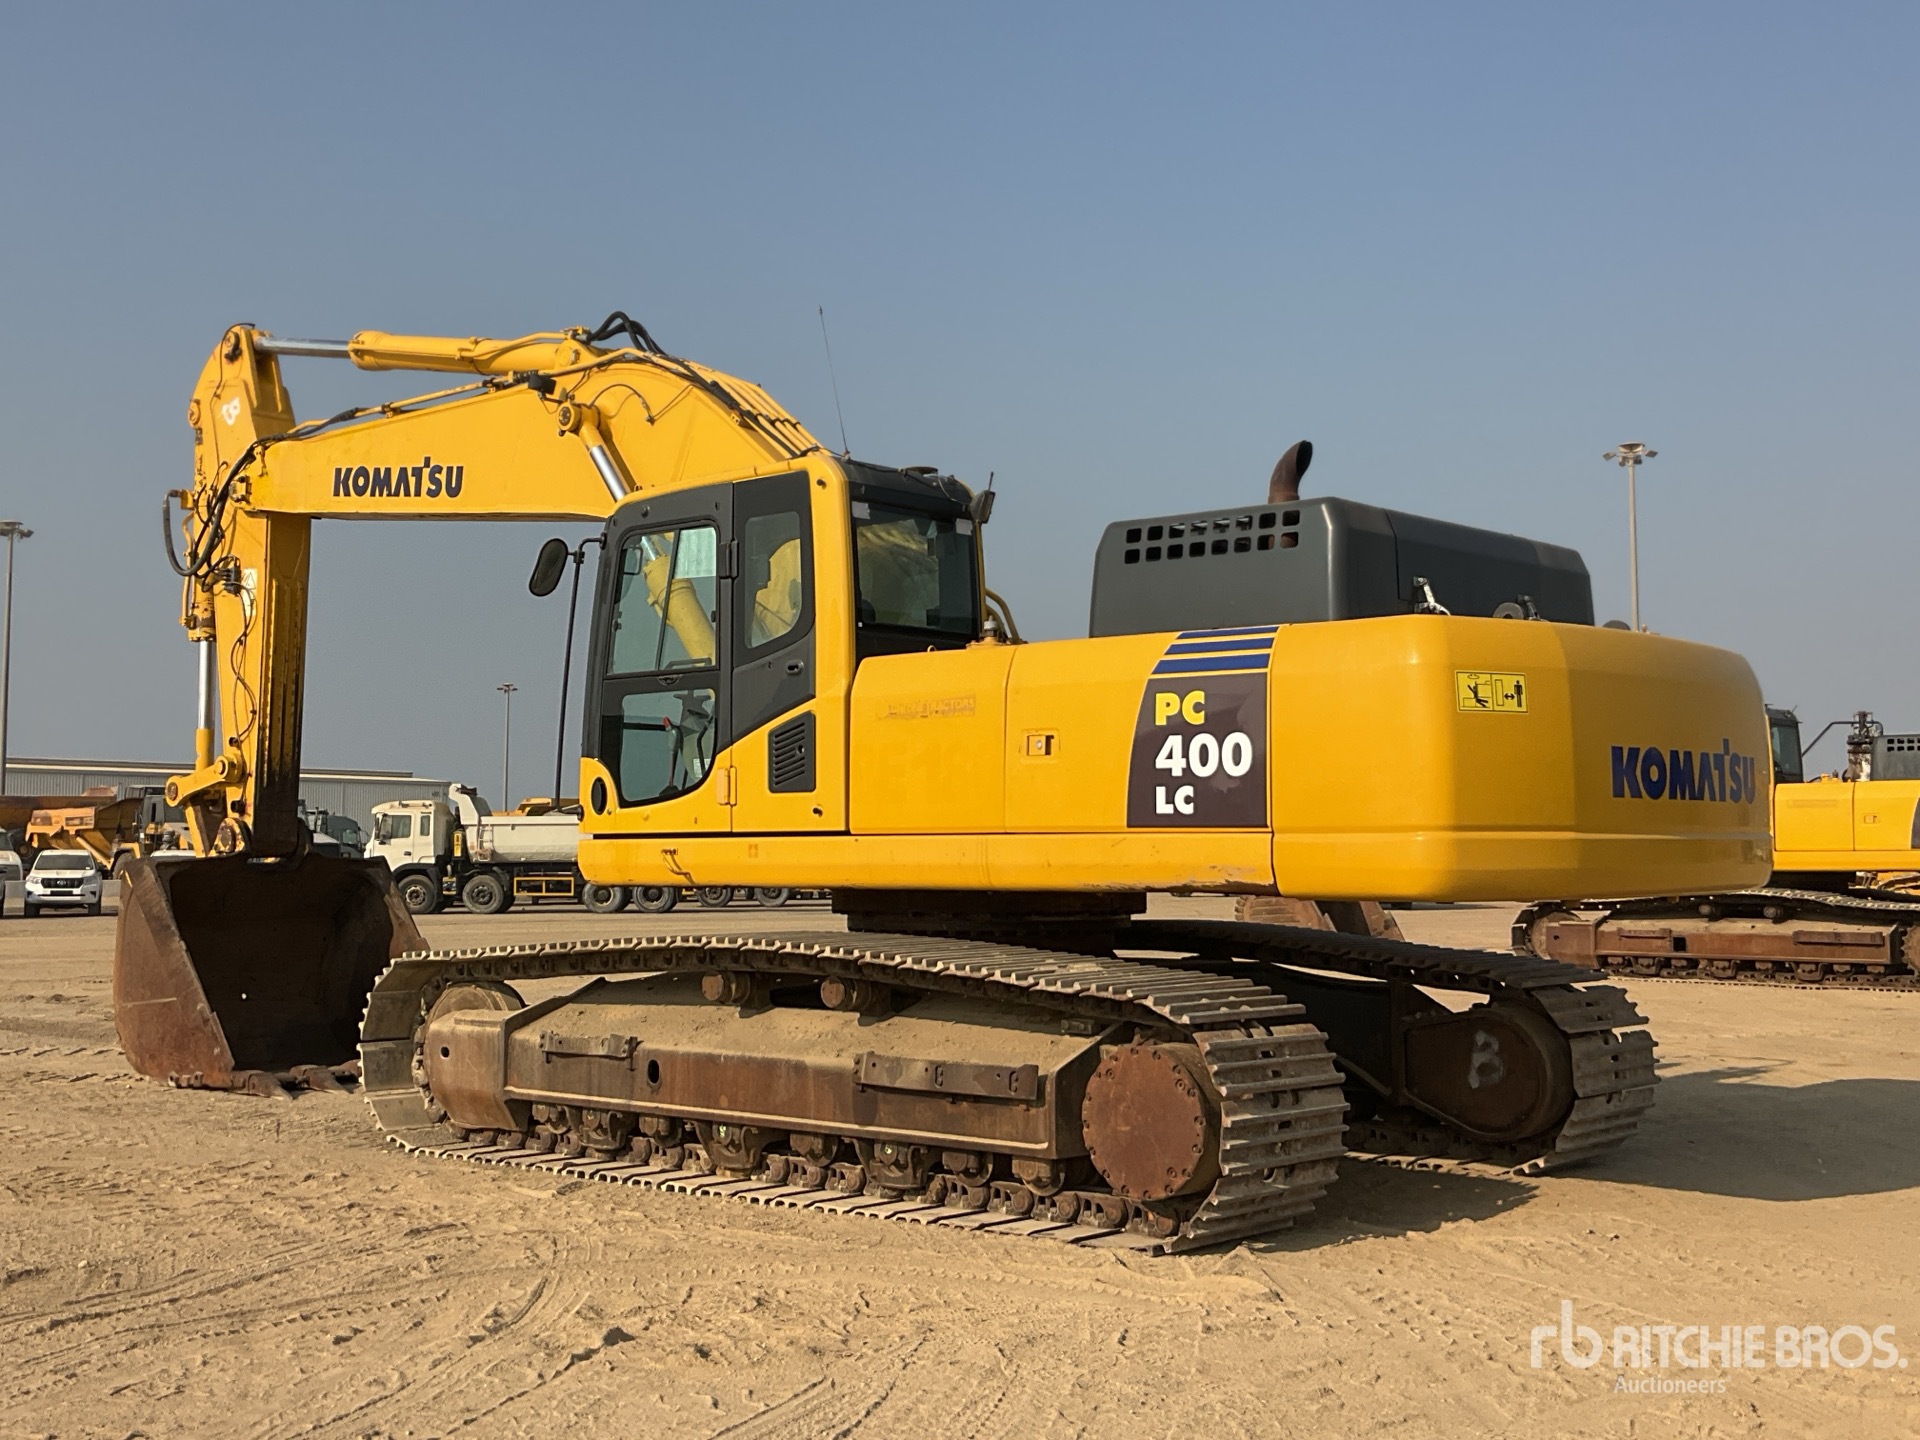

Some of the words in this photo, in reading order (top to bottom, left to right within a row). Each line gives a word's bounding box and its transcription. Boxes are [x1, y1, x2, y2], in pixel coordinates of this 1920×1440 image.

[333, 456, 463, 498] KOMATSU
[1155, 690, 1205, 725] PC
[1155, 732, 1252, 777] 400
[1611, 738, 1755, 805] KOMATSU
[1156, 785, 1194, 814] LC
